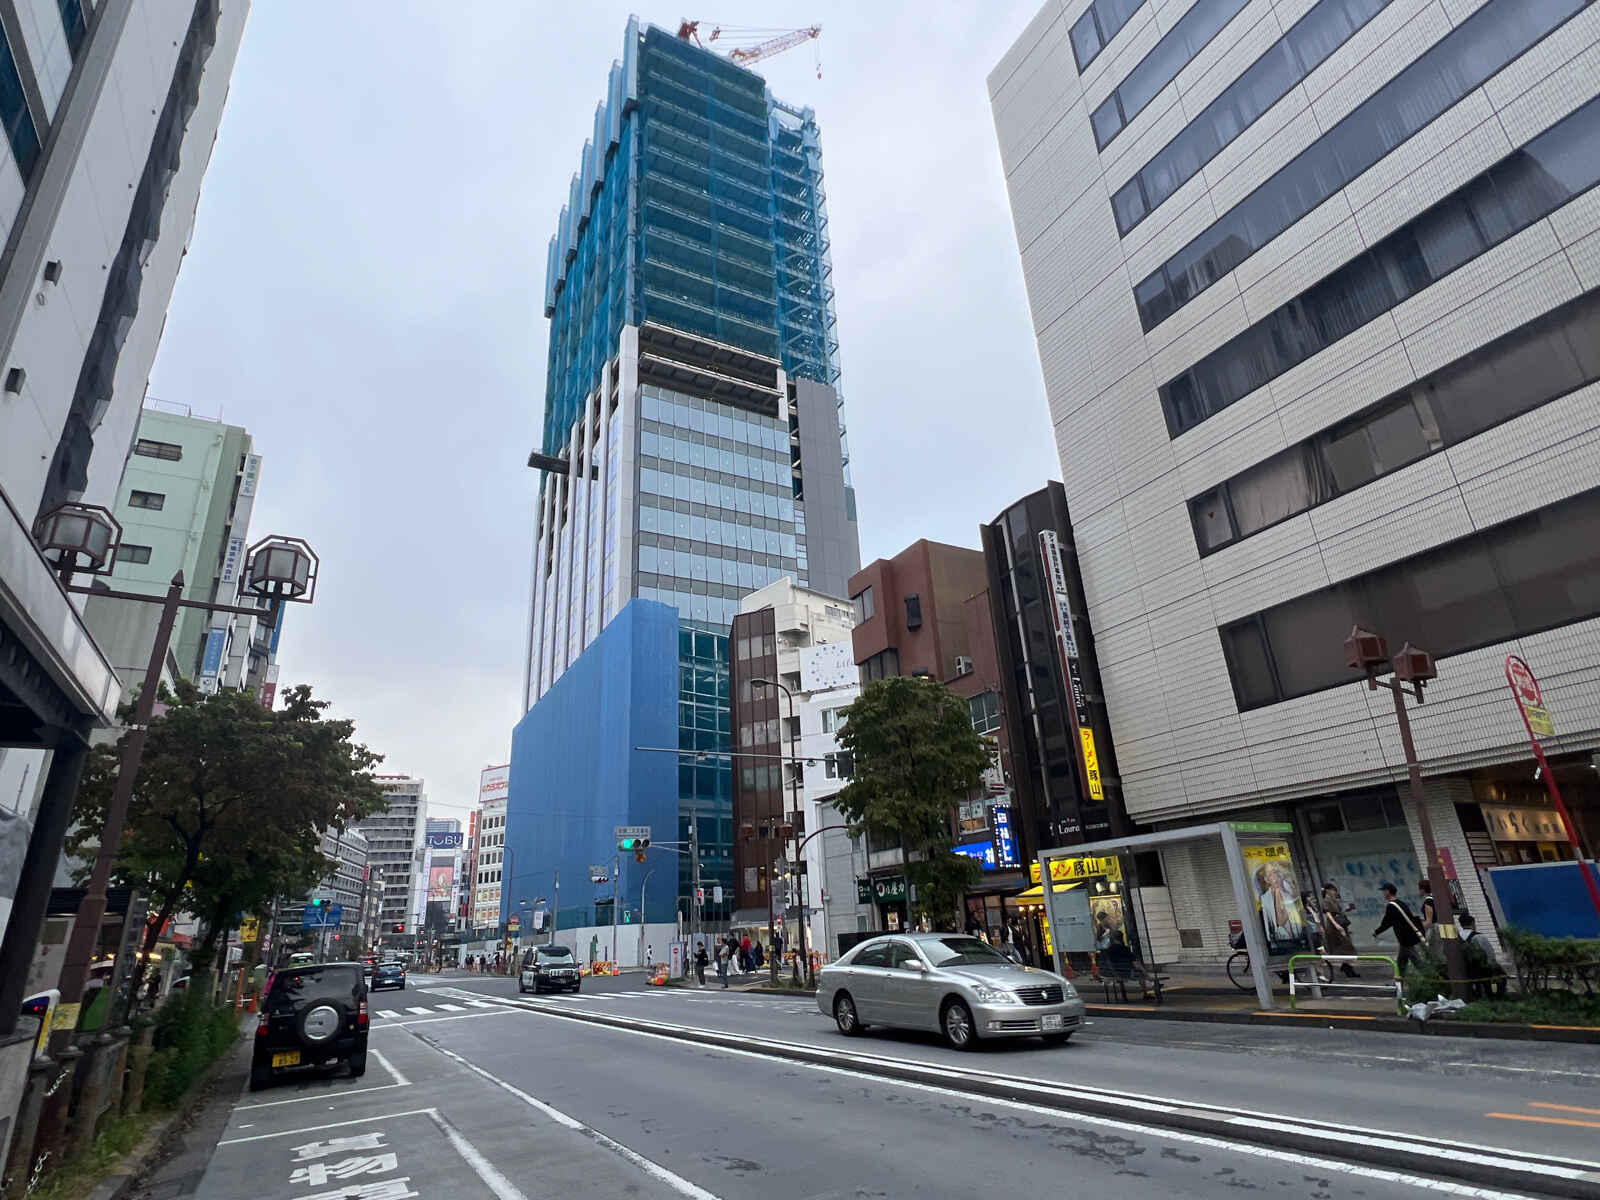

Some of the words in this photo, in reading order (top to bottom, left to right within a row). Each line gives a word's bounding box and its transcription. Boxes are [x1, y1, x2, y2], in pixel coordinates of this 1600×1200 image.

[425, 833, 462, 846] TOBU
[1031, 859, 1100, 880] ラメン豚山
